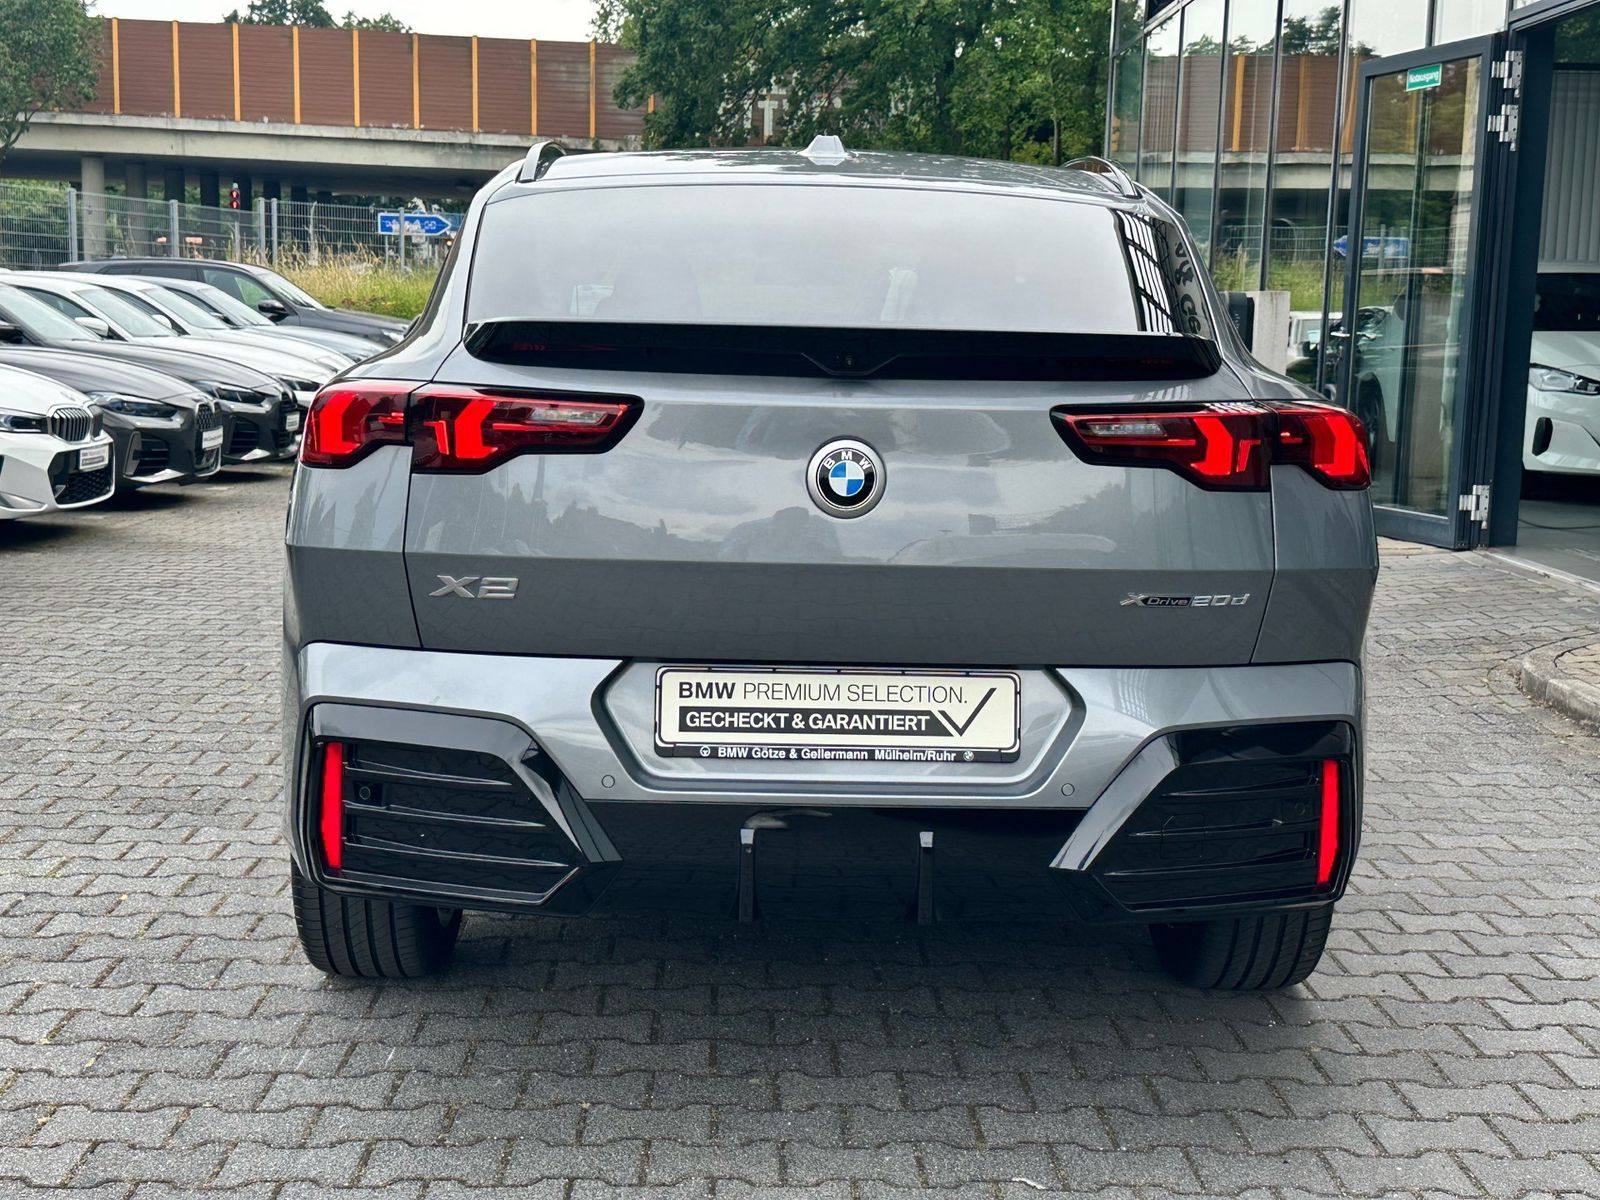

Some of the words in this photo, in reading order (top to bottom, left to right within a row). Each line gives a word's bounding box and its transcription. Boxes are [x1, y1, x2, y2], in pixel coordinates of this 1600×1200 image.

[823, 450, 872, 470] BMW
[428, 574, 519, 600] X2
[678, 681, 736, 699] BMW
[743, 682, 841, 701] PREMIUM
[847, 684, 968, 704] SELECTION.
[685, 711, 789, 729] GECHECKT
[791, 713, 805, 729] &
[808, 713, 930, 731] GARANTIERT
[717, 746, 748, 758] BMW
[751, 746, 786, 759] Götze
[789, 748, 798, 759] &
[801, 748, 868, 760] Gellermann
[874, 749, 957, 762] Mülheim/Ruhr
